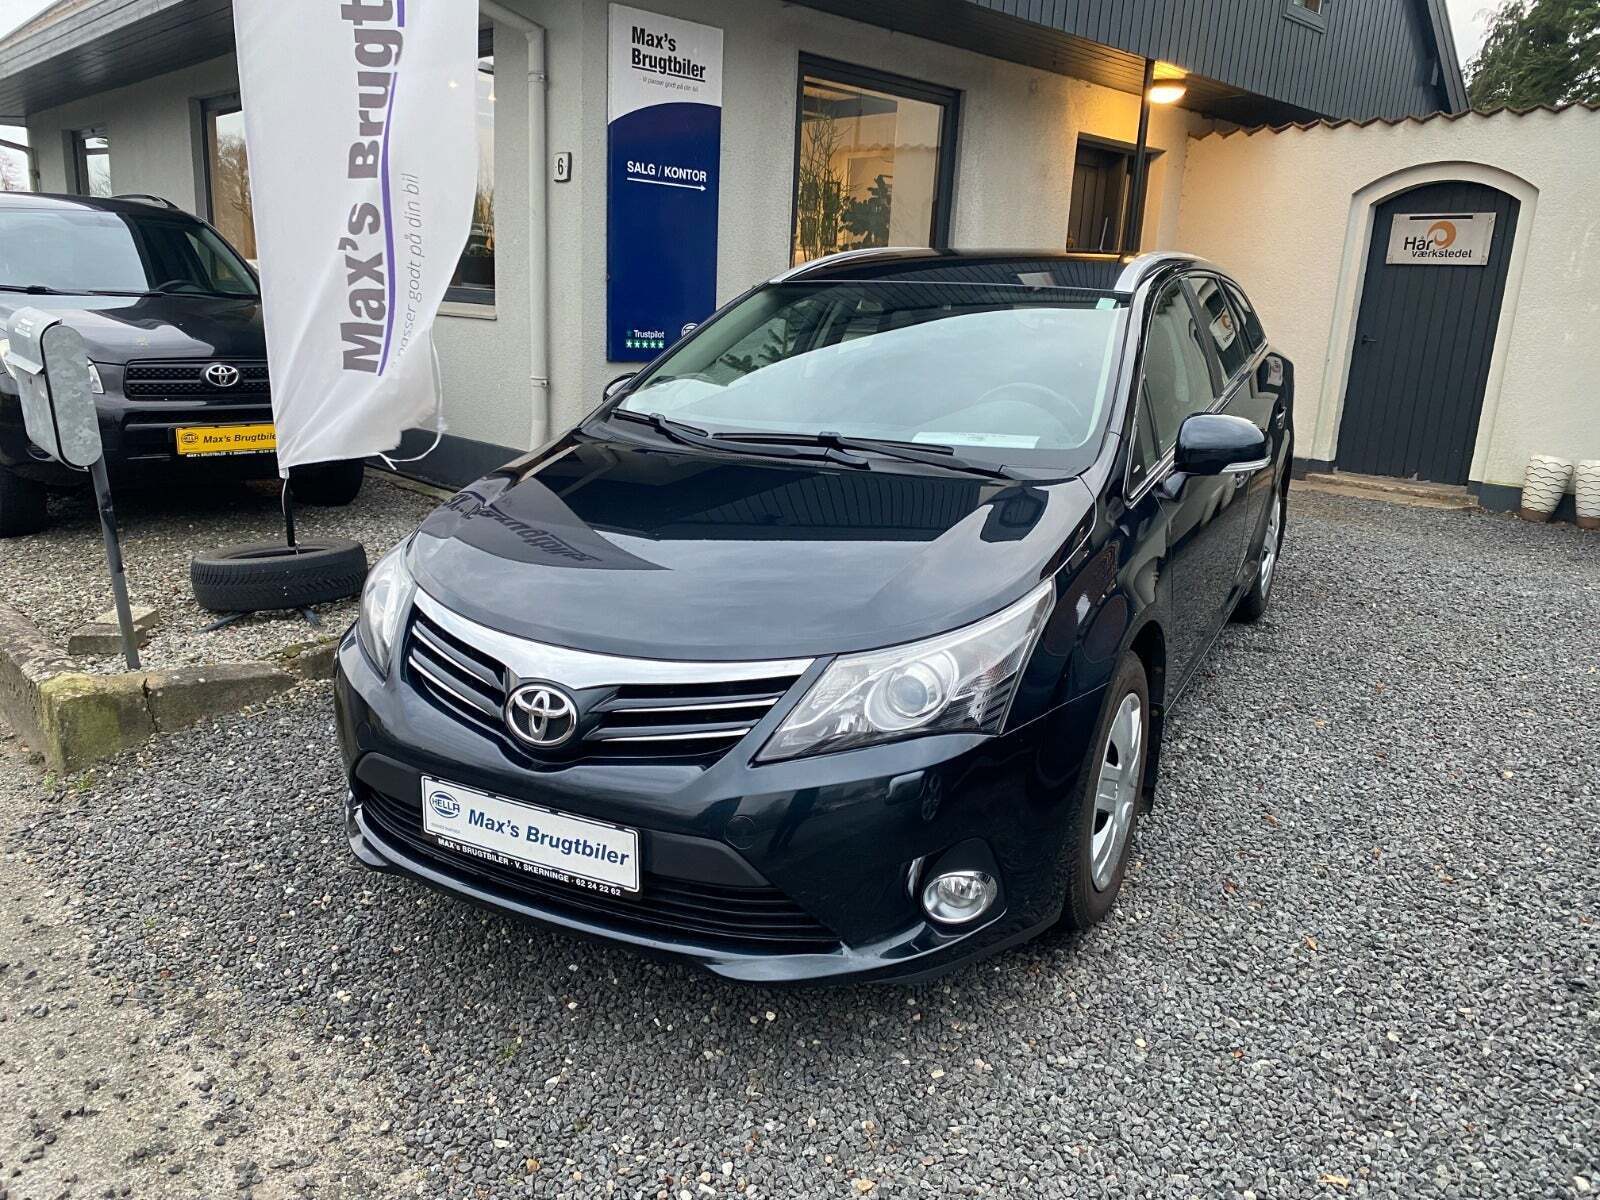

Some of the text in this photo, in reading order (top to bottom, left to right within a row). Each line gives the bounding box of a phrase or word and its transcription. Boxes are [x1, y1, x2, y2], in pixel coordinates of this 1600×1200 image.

[631, 26, 676, 52] Max's
[631, 48, 706, 79] Brugtbiler
[557, 157, 564, 175] 6
[627, 160, 656, 175] SALG
[664, 166, 707, 182] KONTOR
[401, 173, 420, 195] bil
[404, 201, 421, 228] din
[404, 233, 425, 258] på
[1403, 236, 1434, 251] Hår
[1411, 249, 1472, 258] værkstedet
[338, 202, 386, 373] Max's
[407, 259, 423, 303] godt
[633, 329, 665, 340] Trustpilot
[203, 435, 231, 444] Max's
[468, 808, 630, 865] Max's Brugtbiler
[462, 845, 509, 866] BRUGTBILER
[523, 864, 570, 883] SKERNINGE
[575, 878, 586, 887] 62
[587, 881, 598, 891] 24
[599, 884, 609, 894] 22
[610, 888, 621, 897] 62
